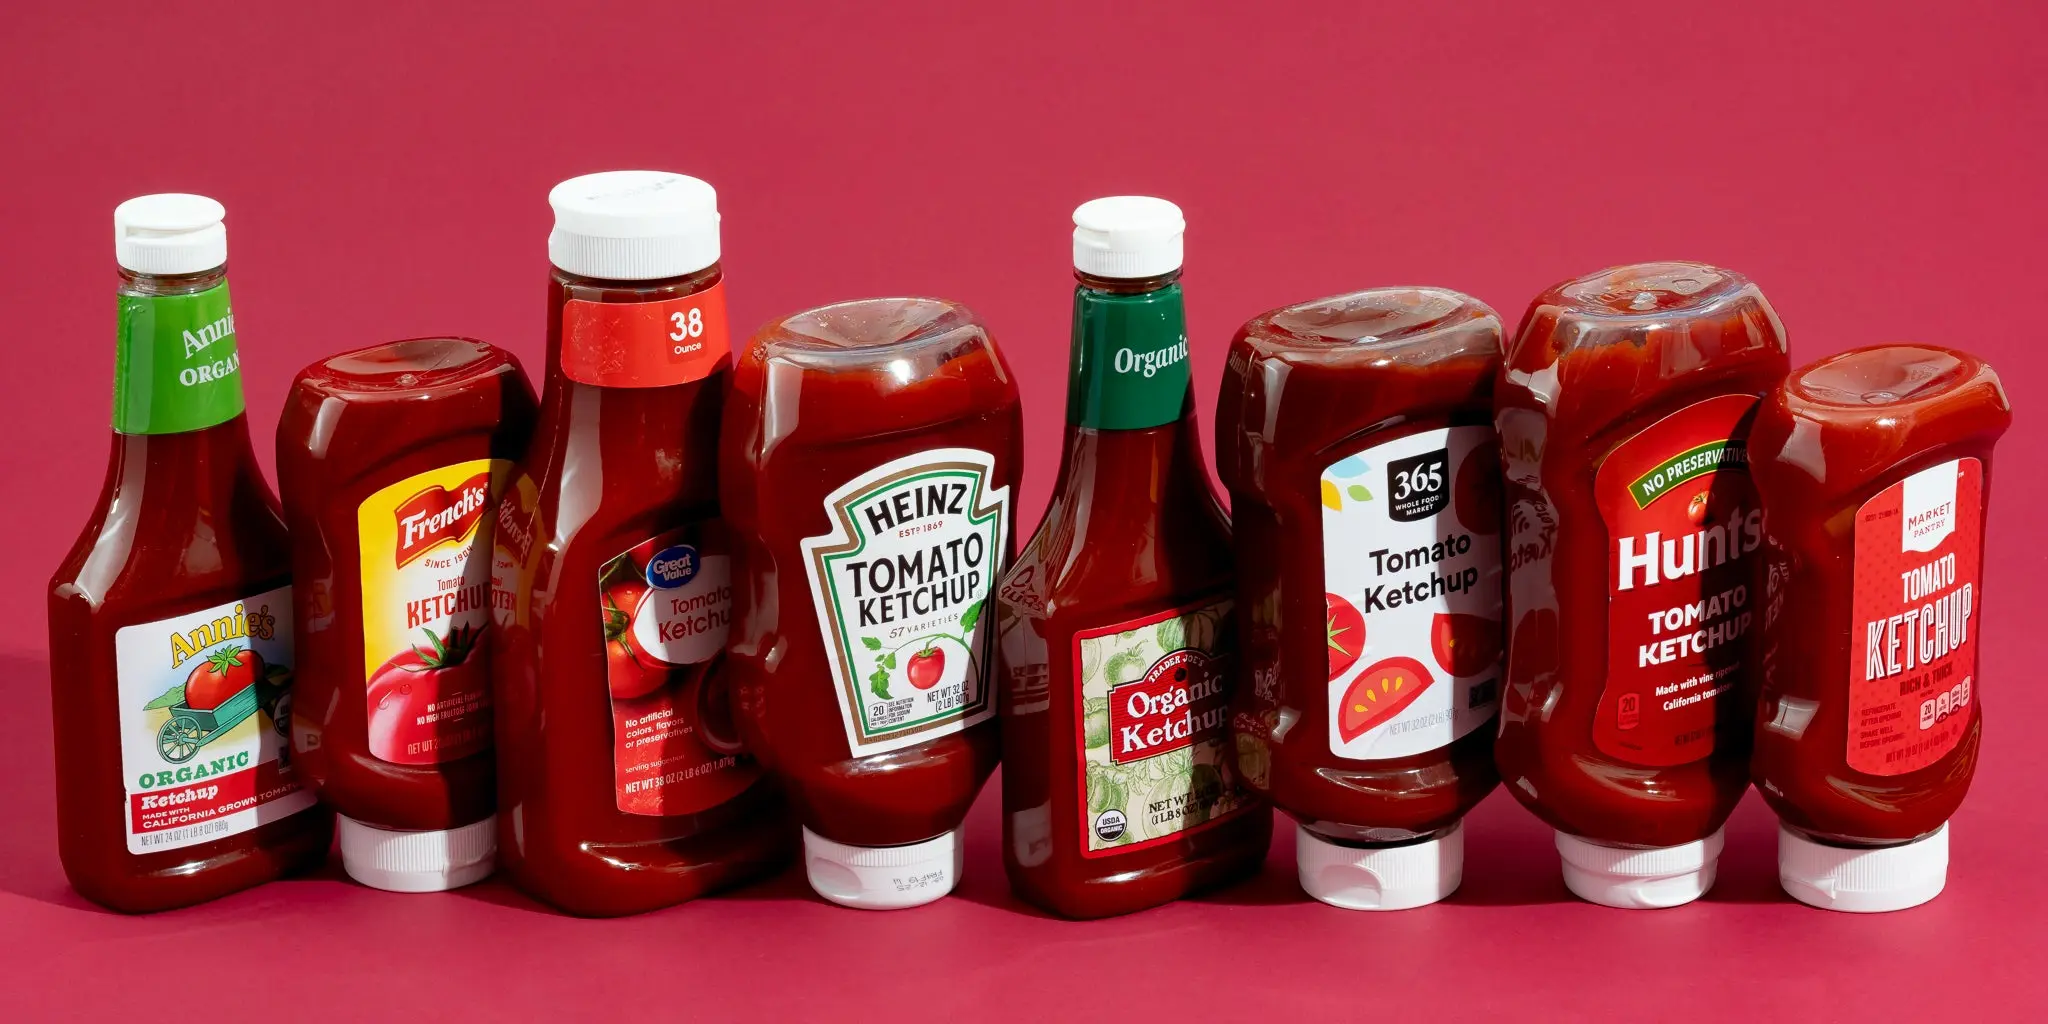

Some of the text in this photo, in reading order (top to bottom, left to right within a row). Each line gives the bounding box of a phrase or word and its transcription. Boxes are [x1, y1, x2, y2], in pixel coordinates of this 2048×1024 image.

[669, 307, 704, 342] 38
[674, 342, 702, 355] Ounce
[1114, 333, 1189, 378] Organic
[1394, 461, 1443, 501] 365
[1642, 446, 1749, 497] NO PRESERVATIVE
[863, 483, 968, 536] HEINZ
[1395, 499, 1420, 511] WHOLE
[1406, 503, 1434, 516] MARKET
[1908, 501, 1952, 531] MARKET
[400, 486, 485, 551] French's
[922, 520, 943, 533] 1869
[1913, 518, 1946, 538] PANTRY
[424, 556, 451, 569] SINCE
[653, 553, 692, 574] Great
[845, 532, 984, 598] TOMATO
[1369, 533, 1471, 577] Tomato
[437, 575, 465, 592] Tomato
[662, 566, 692, 581] Value
[1901, 552, 1956, 604] TOMATO
[671, 586, 732, 616] Tomato
[858, 570, 980, 628] KETCHUP
[1364, 566, 1478, 614] Ketchup
[1648, 584, 1747, 635] TOMATO
[169, 603, 275, 670] Annie's
[658, 608, 732, 644] Ketchu
[889, 613, 959, 639] 57 VARIETIES
[1865, 582, 1973, 682] KETCHUP
[1638, 610, 1752, 668] KETCHUP
[1148, 653, 1204, 684] TRADER JOE'S
[1899, 678, 1922, 697] RICH
[1922, 672, 1931, 688] &
[1932, 661, 1953, 684] THICK
[927, 680, 969, 703] NET WT 32 OZ
[1127, 671, 1223, 719] Organic
[1655, 683, 1679, 697] Made
[1680, 677, 1698, 690] with
[1698, 671, 1714, 684] vine
[427, 703, 436, 713] NO
[873, 705, 884, 716] 20
[1622, 696, 1636, 713] 20
[1663, 694, 1702, 712] California
[1924, 703, 1932, 715] 20
[416, 716, 425, 726] NO
[426, 713, 440, 724] HIGH
[625, 708, 674, 729] No artificial
[626, 717, 684, 739] colors, flavors
[1120, 704, 1229, 754] Ketchup
[1389, 722, 1401, 736] NET
[1402, 720, 1411, 733] WT
[407, 739, 433, 756] NET WT
[625, 726, 693, 749] or preservatives
[138, 750, 249, 789] ORGANIC
[625, 753, 685, 774] serving suggestion
[625, 781, 640, 794] NET
[641, 778, 654, 791] WT
[655, 776, 664, 788] 38
[665, 773, 676, 785] OZ
[676, 770, 684, 783] (2
[685, 768, 694, 780] LB
[695, 766, 700, 776] 6
[141, 784, 219, 811] Ketchup
[1149, 798, 1172, 813] NET
[142, 807, 190, 820] MADE WITH
[143, 809, 216, 829] CALIFORNIA
[218, 796, 258, 814] GROWN
[1102, 816, 1121, 826] USDA
[1160, 811, 1175, 822] LB
[1176, 808, 1181, 818] 8
[141, 834, 153, 846] NET
[153, 832, 164, 845] WT
[165, 832, 173, 843] 24
[174, 830, 181, 841] OZ
[1100, 824, 1123, 834] ORGANIC
